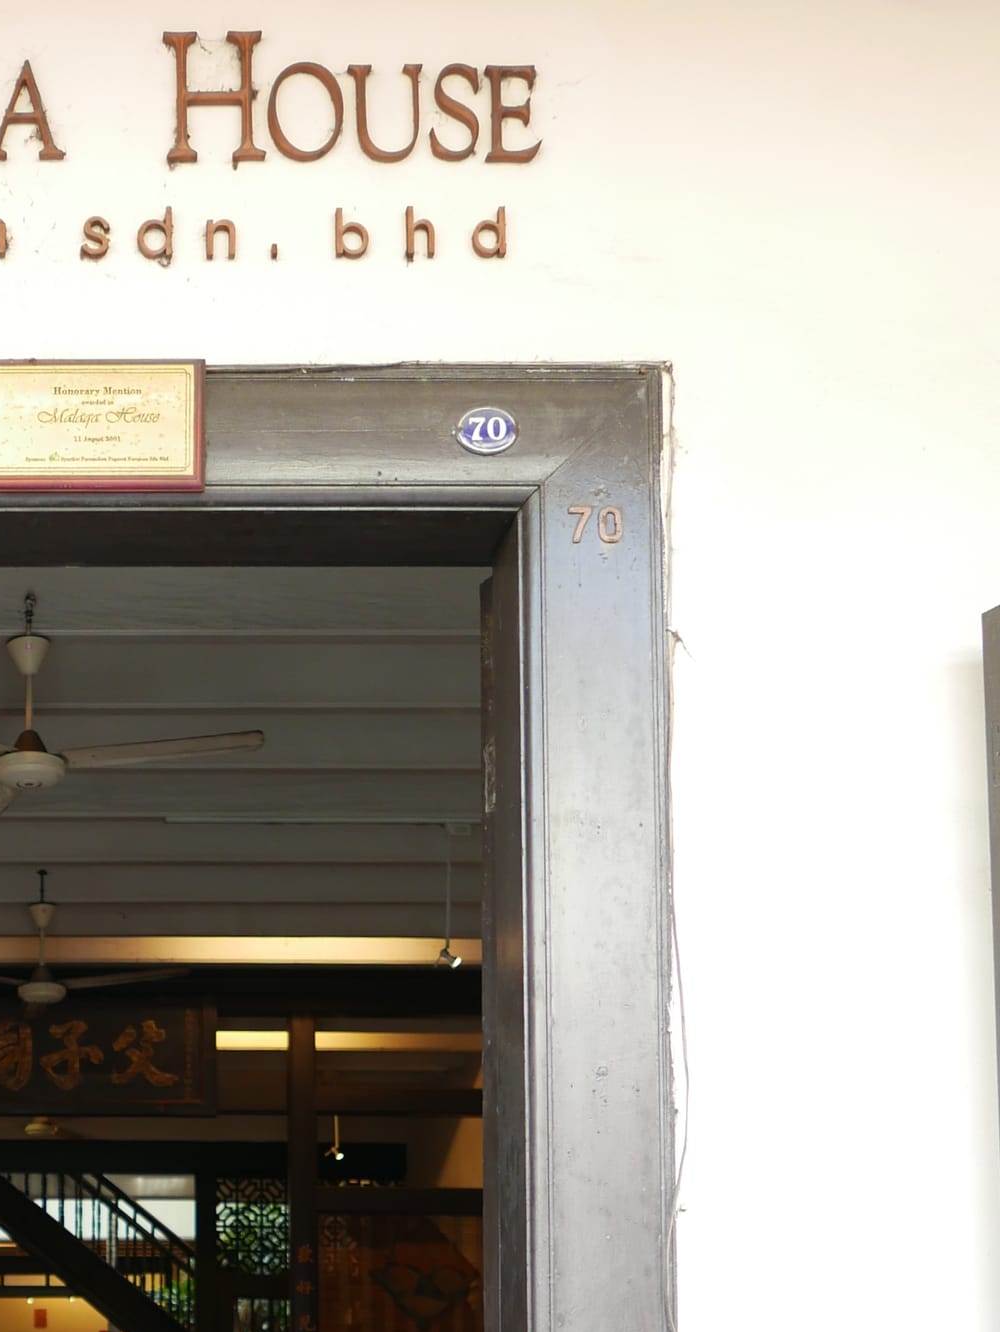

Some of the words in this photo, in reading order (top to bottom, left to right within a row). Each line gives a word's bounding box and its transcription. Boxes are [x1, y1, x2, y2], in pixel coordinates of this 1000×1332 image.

[161, 30, 542, 164] HOUSE
[336, 206, 507, 260] bhd
[53, 386, 100, 397] Honorary
[103, 386, 142, 395] Mention
[37, 408, 102, 428] Malaqa
[105, 407, 160, 424] House
[468, 416, 507, 441] 70
[568, 504, 624, 544] 70
